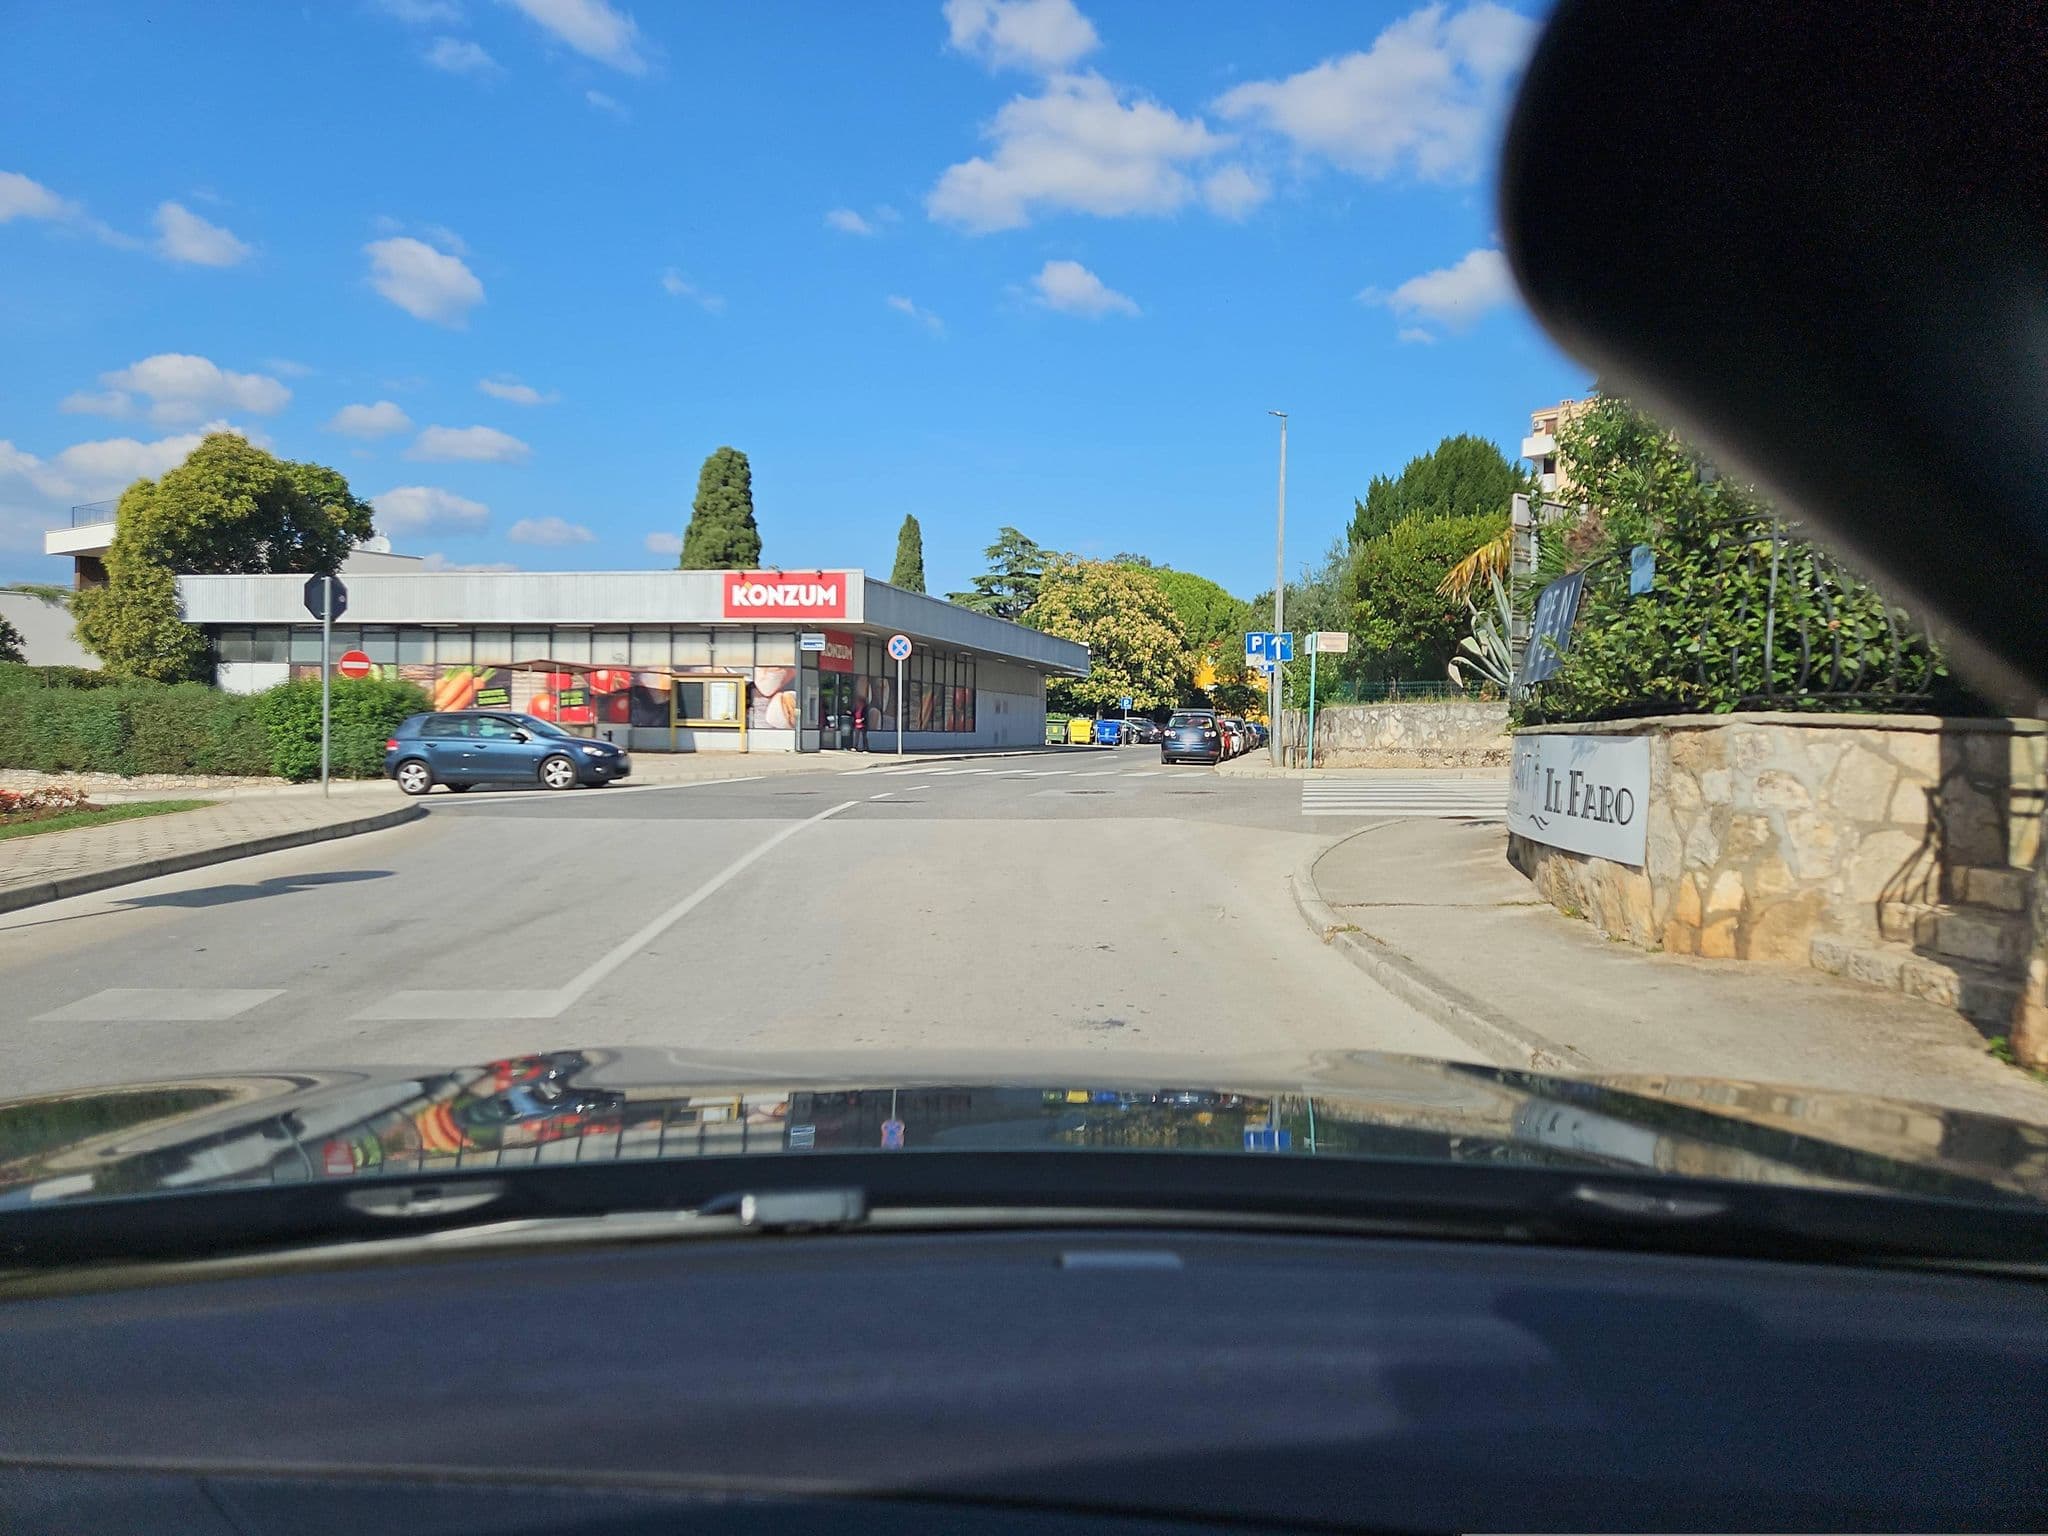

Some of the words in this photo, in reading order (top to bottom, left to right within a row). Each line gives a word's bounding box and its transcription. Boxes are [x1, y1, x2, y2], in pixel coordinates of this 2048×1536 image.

[732, 583, 837, 606] KONZUM
[1252, 636, 1263, 652] P
[1567, 770, 1635, 826] FARO
